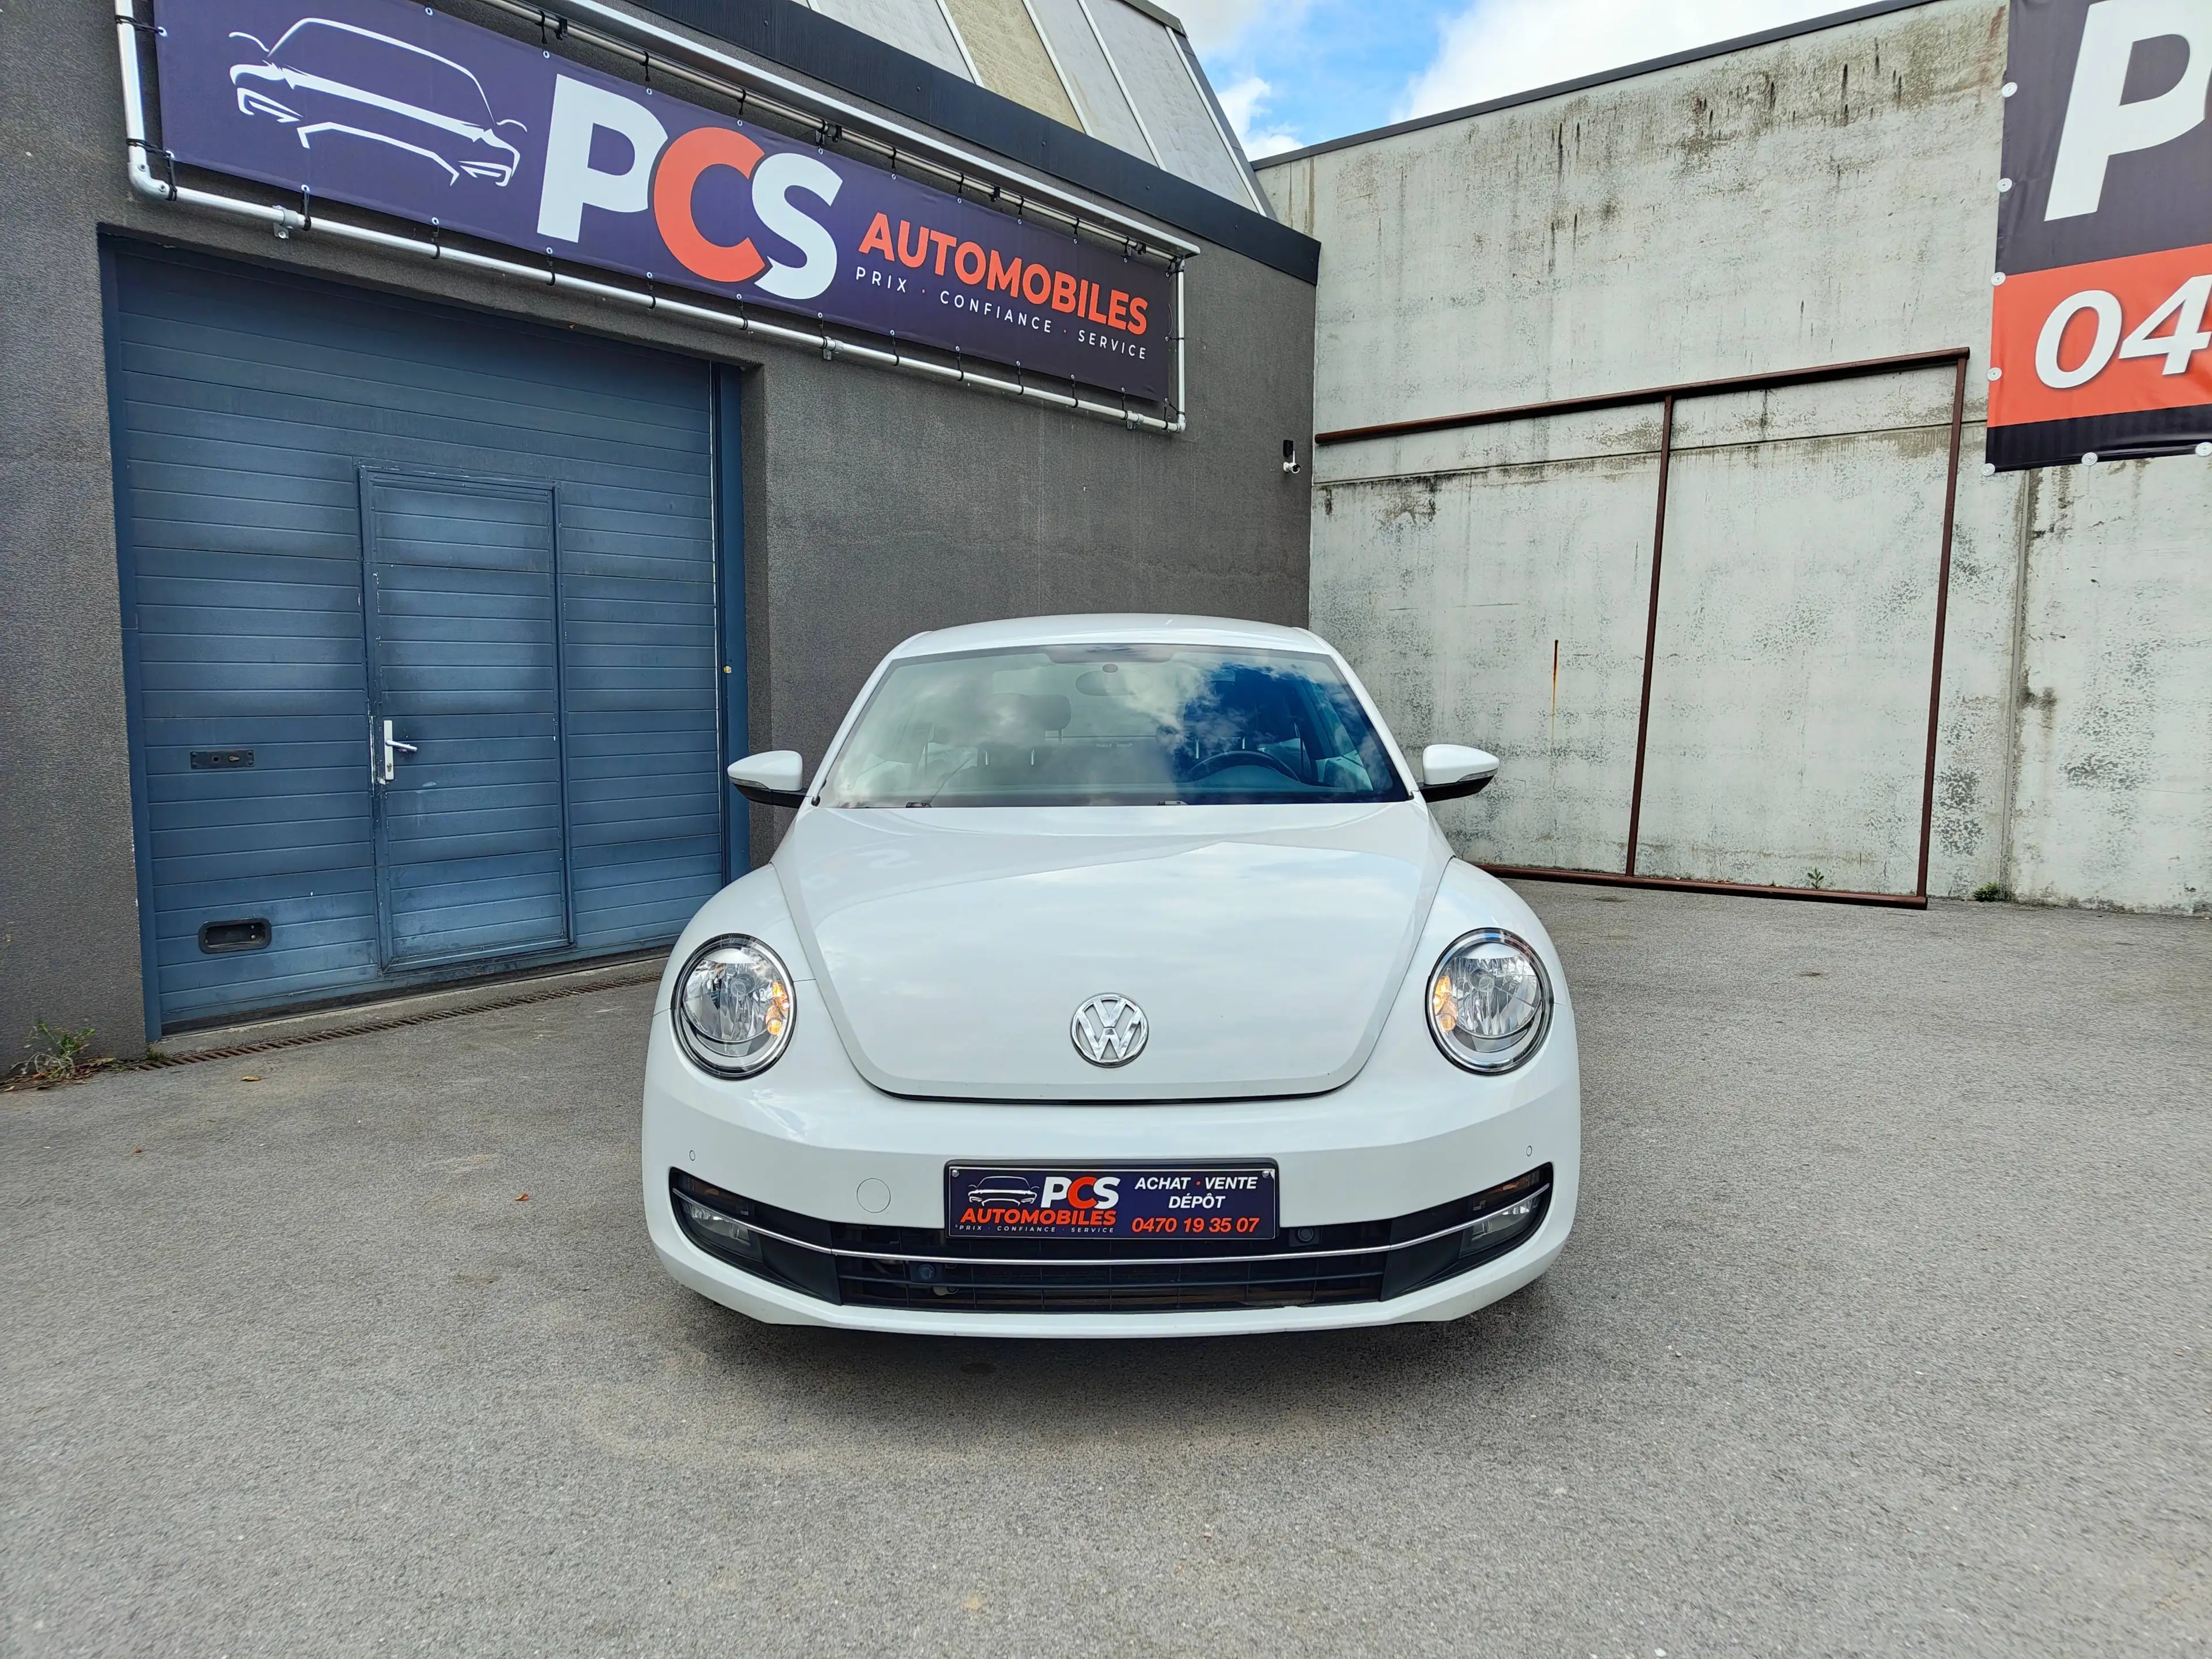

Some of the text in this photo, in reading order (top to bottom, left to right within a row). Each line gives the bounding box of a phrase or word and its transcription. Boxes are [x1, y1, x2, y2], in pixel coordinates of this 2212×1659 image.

[536, 74, 843, 300] PCS
[858, 212, 1148, 335] AUTOMOBILES
[855, 266, 1146, 360] PRIX CONFIANCE SERVICE
[1040, 1176, 1120, 1209] PCS
[1134, 1177, 1258, 1190] ACHAT VENTE
[1168, 1193, 1226, 1209] DÉPÔT
[960, 1208, 1116, 1225] AUTOMOBILES
[1131, 1217, 1260, 1233] 0470 19 35 07
